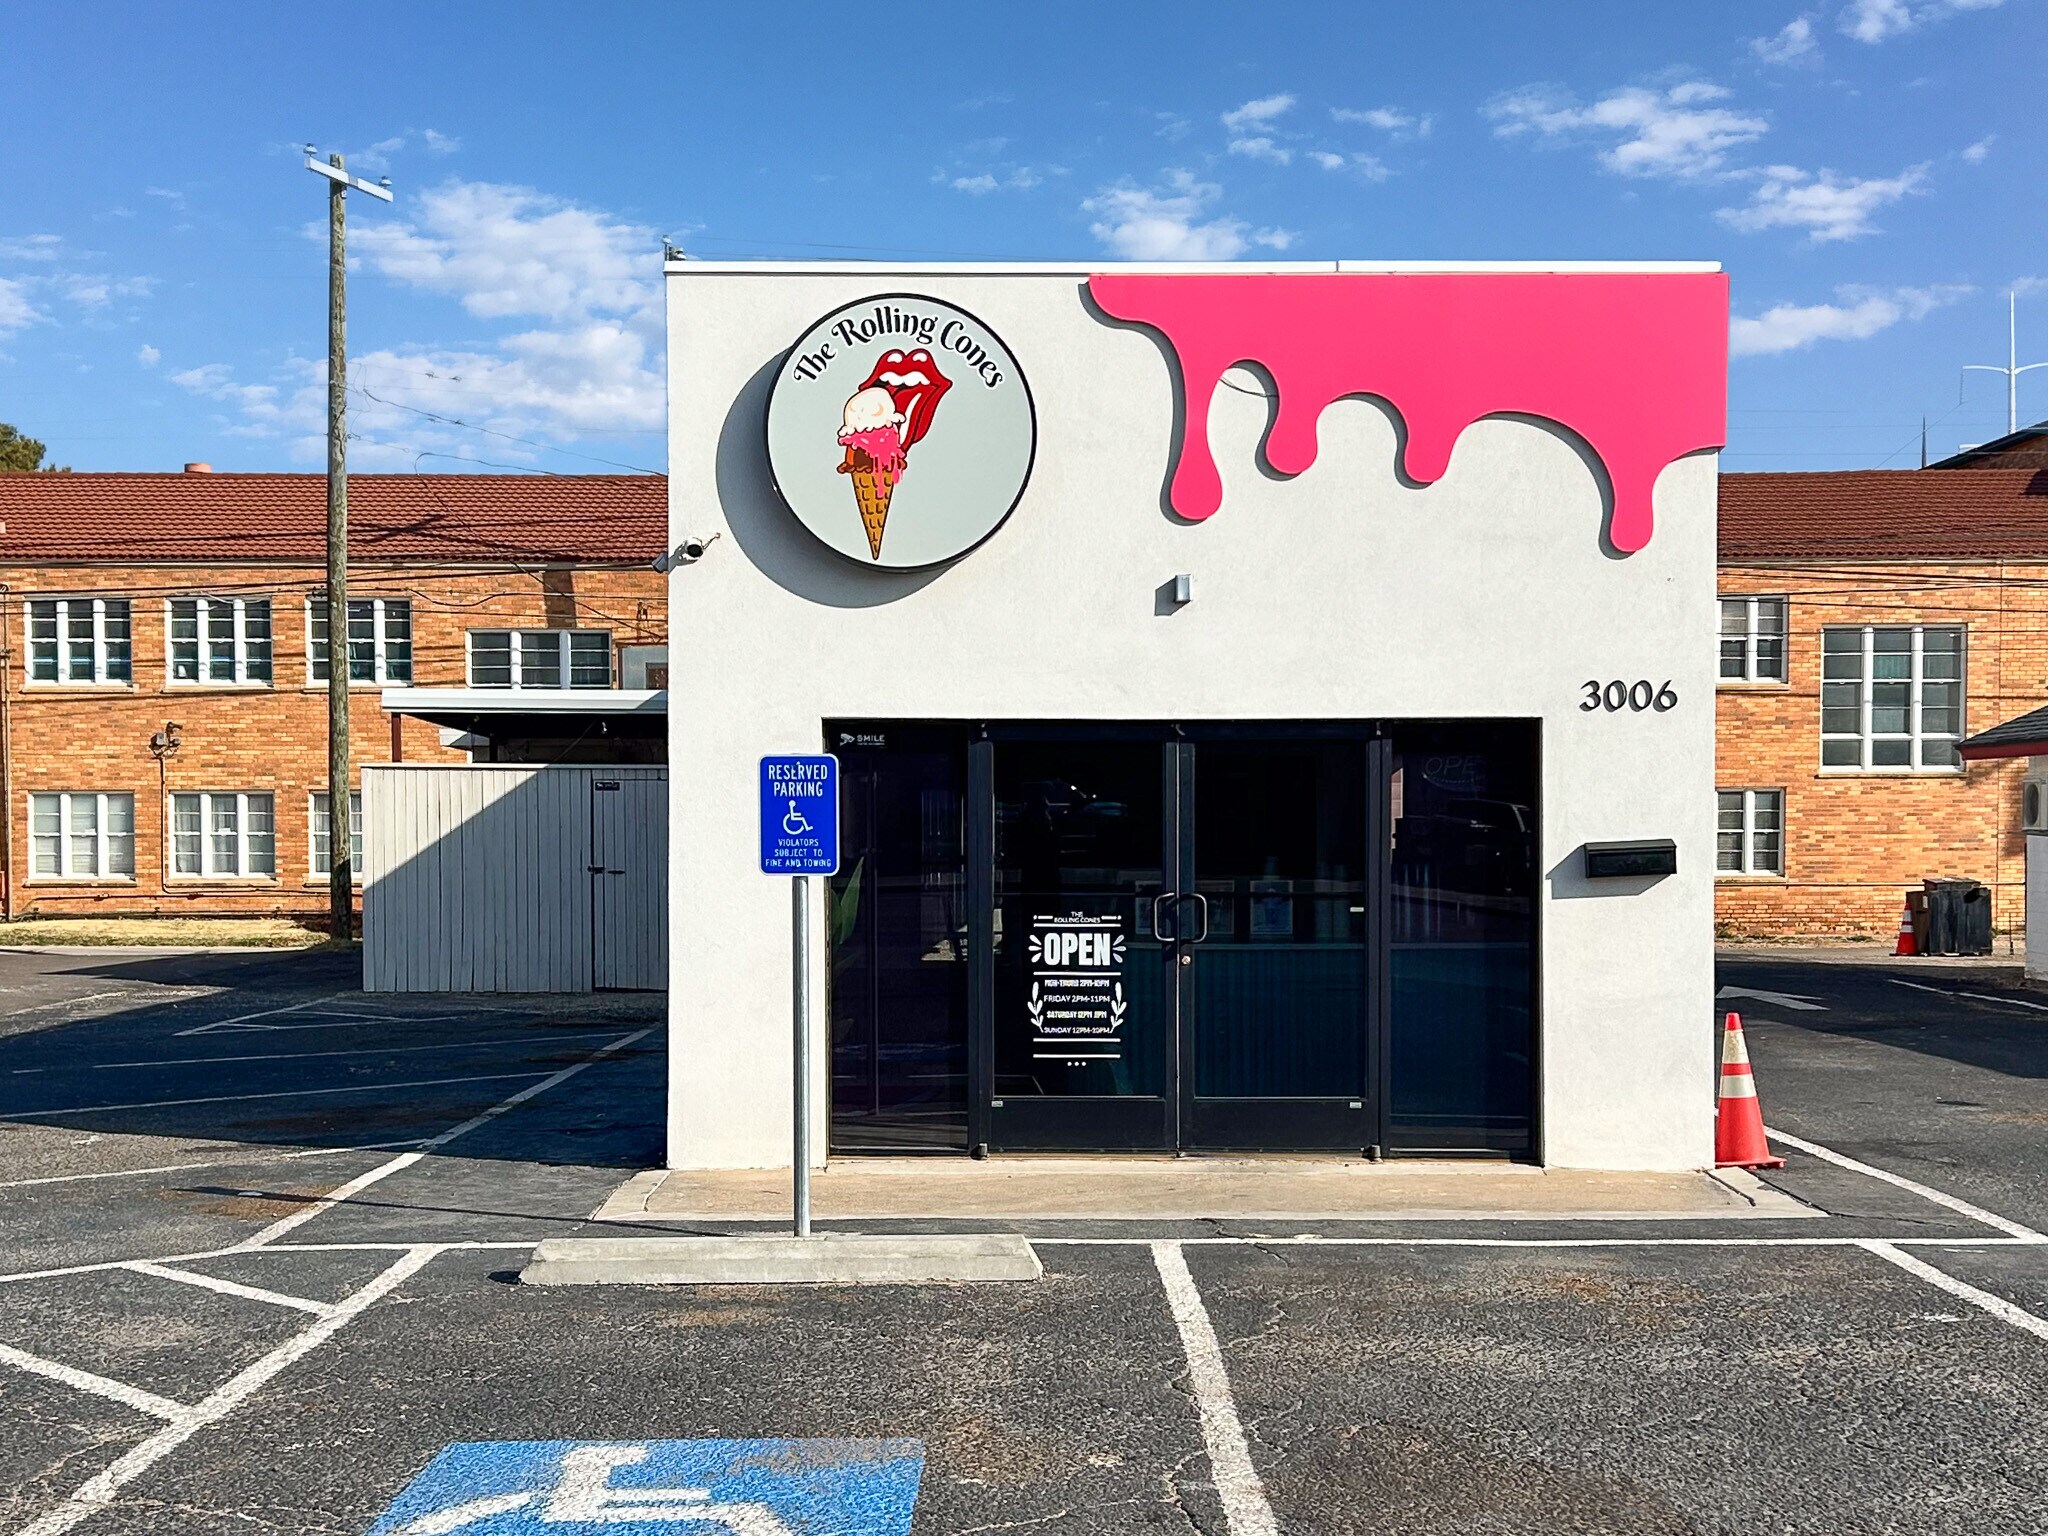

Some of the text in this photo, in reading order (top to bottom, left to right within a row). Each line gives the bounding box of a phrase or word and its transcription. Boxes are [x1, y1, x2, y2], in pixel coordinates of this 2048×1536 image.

[794, 306, 1003, 388] The Rolling Cones
[1579, 680, 1678, 712] 3006
[768, 764, 828, 780] RESERVED
[773, 781, 823, 797] PARKING
[778, 838, 819, 847] VIOLATORS
[774, 848, 823, 857] SUBJECT TO
[765, 858, 832, 867] FINE AND TOWING
[1044, 933, 1111, 966] OPEN
[1043, 995, 1111, 1003] FRIDAY 2PM-11PM
[1043, 1026, 1072, 1034] SUNDAY
